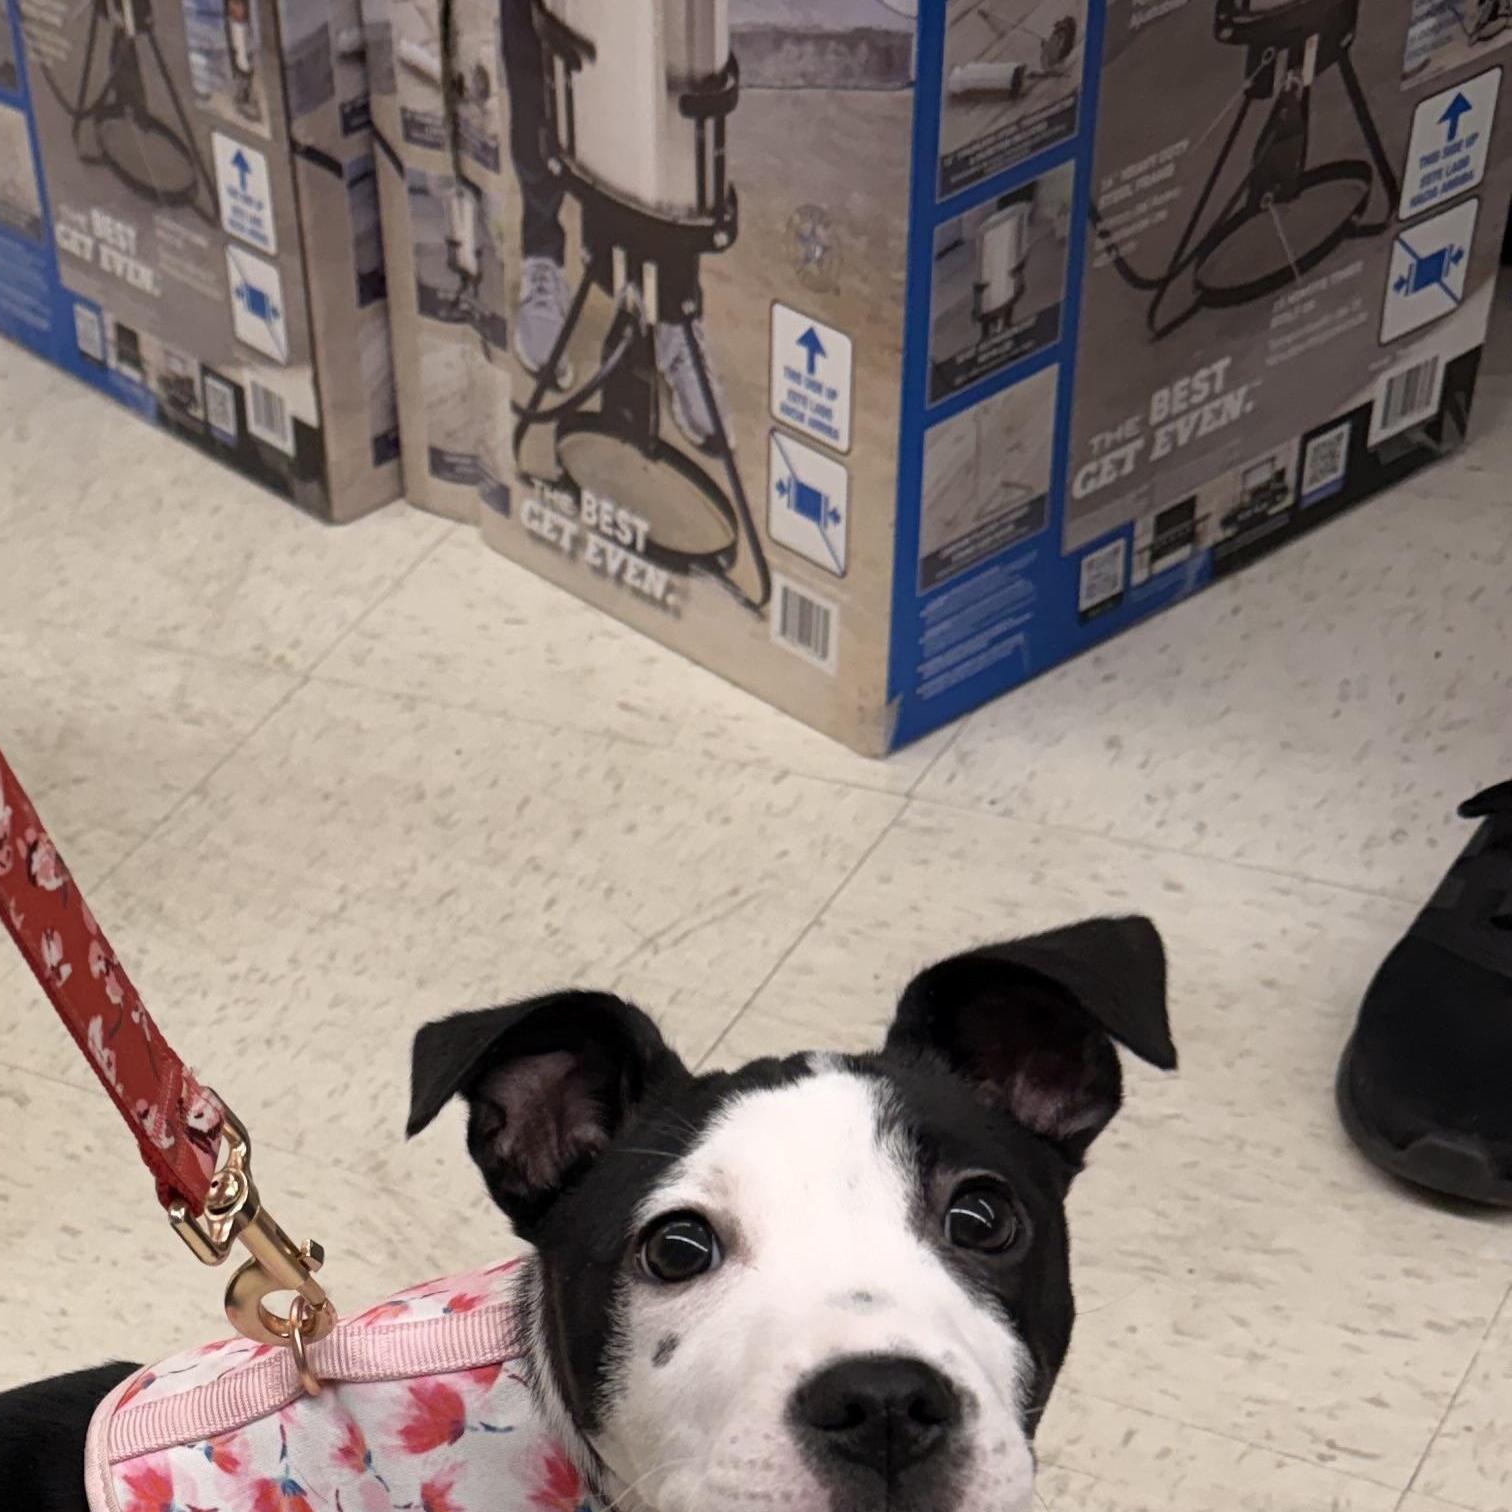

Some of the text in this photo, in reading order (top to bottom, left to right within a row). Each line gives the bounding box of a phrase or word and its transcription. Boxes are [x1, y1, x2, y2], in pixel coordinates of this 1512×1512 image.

[1072, 384, 1255, 499] GET EVEN.
[1090, 356, 1232, 454] THE BEST
[520, 499, 678, 606] GET EVEN.
[530, 477, 651, 553] THE BEST
